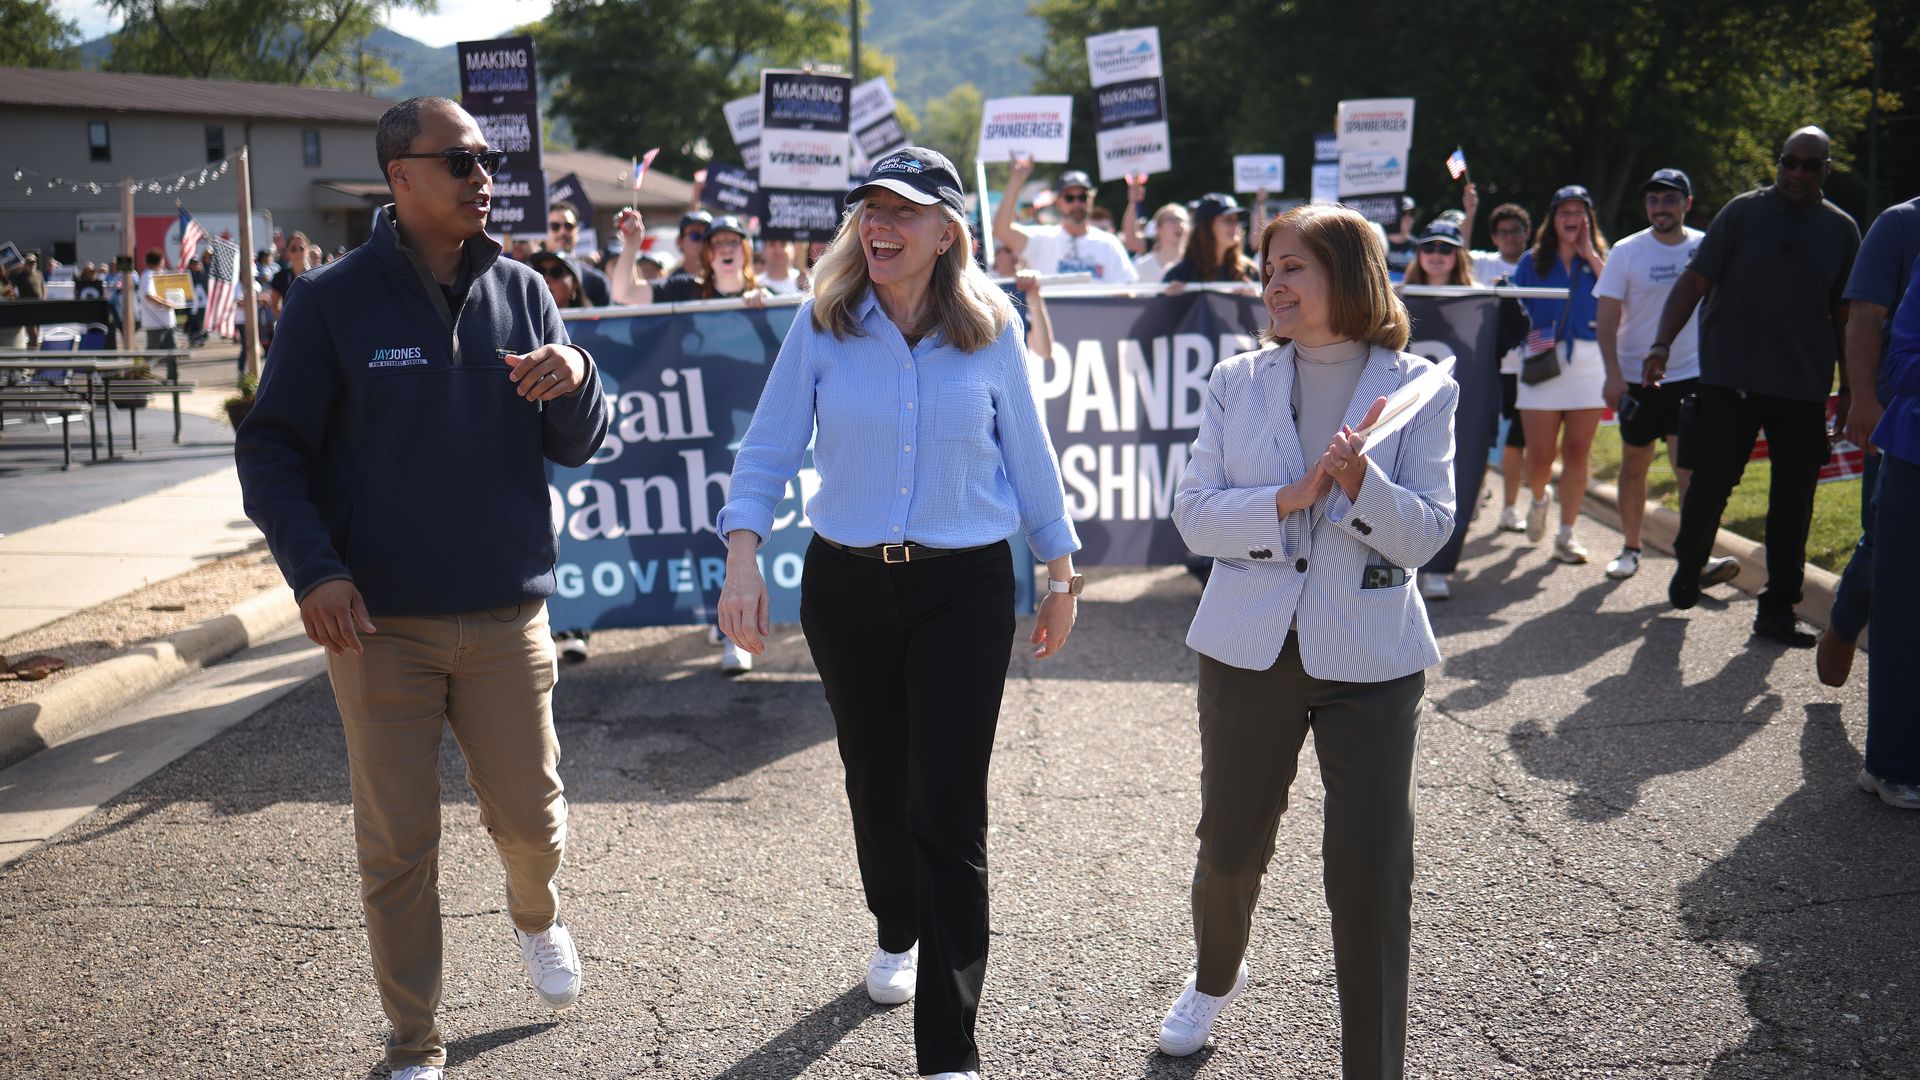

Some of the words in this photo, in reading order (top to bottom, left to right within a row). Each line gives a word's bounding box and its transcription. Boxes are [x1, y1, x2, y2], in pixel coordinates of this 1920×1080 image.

[466, 50, 527, 70] MAKING
[773, 83, 843, 103] MAKING
[1099, 86, 1156, 107] MAKING
[985, 121, 1064, 140] SPANBERGER
[1343, 118, 1408, 134] SPANBERGER
[769, 151, 842, 168] VIRGINIA
[585, 368, 714, 464] gail
[1061, 443, 1201, 522] SHM
[557, 551, 803, 598] GOVERO
